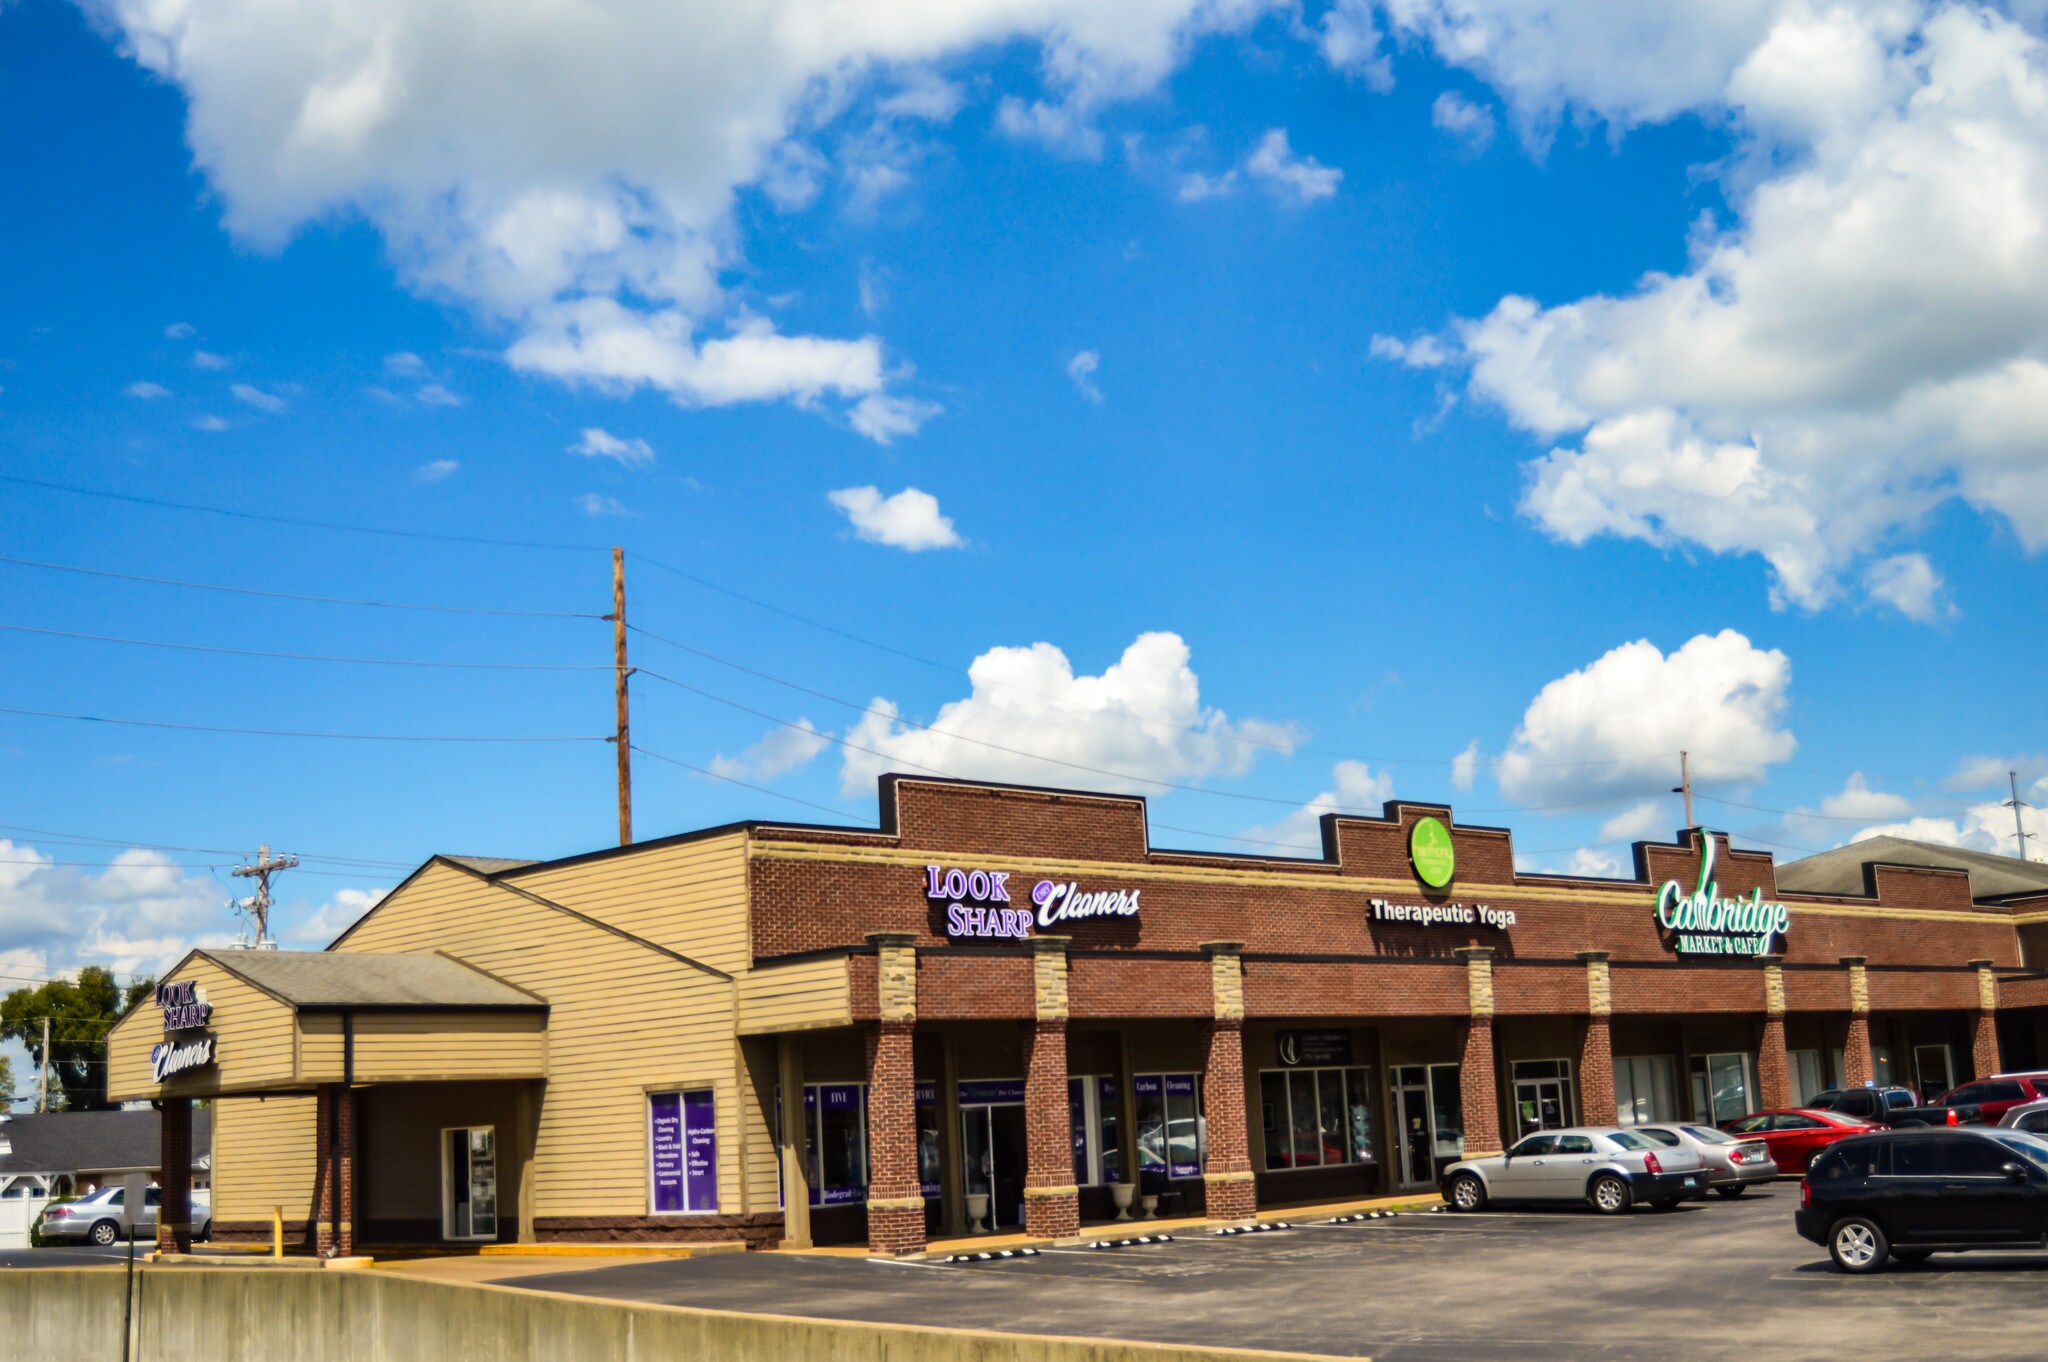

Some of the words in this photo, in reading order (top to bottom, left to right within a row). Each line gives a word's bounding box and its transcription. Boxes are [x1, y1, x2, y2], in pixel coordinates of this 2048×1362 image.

[927, 865, 1010, 902] LOOK
[947, 902, 1033, 938] SHARP
[1037, 882, 1140, 927] Cleaners
[1370, 899, 1473, 926] Therapeutic
[1476, 904, 1516, 929] Yoga
[1656, 880, 1790, 956] Cambridge
[1678, 934, 1723, 954] MARKET
[1723, 936, 1733, 954] &
[155, 981, 194, 1007] LOOK
[164, 1004, 208, 1031] SHARP
[153, 1039, 212, 1083] Cleaners
[831, 1092, 848, 1103] FIVE
